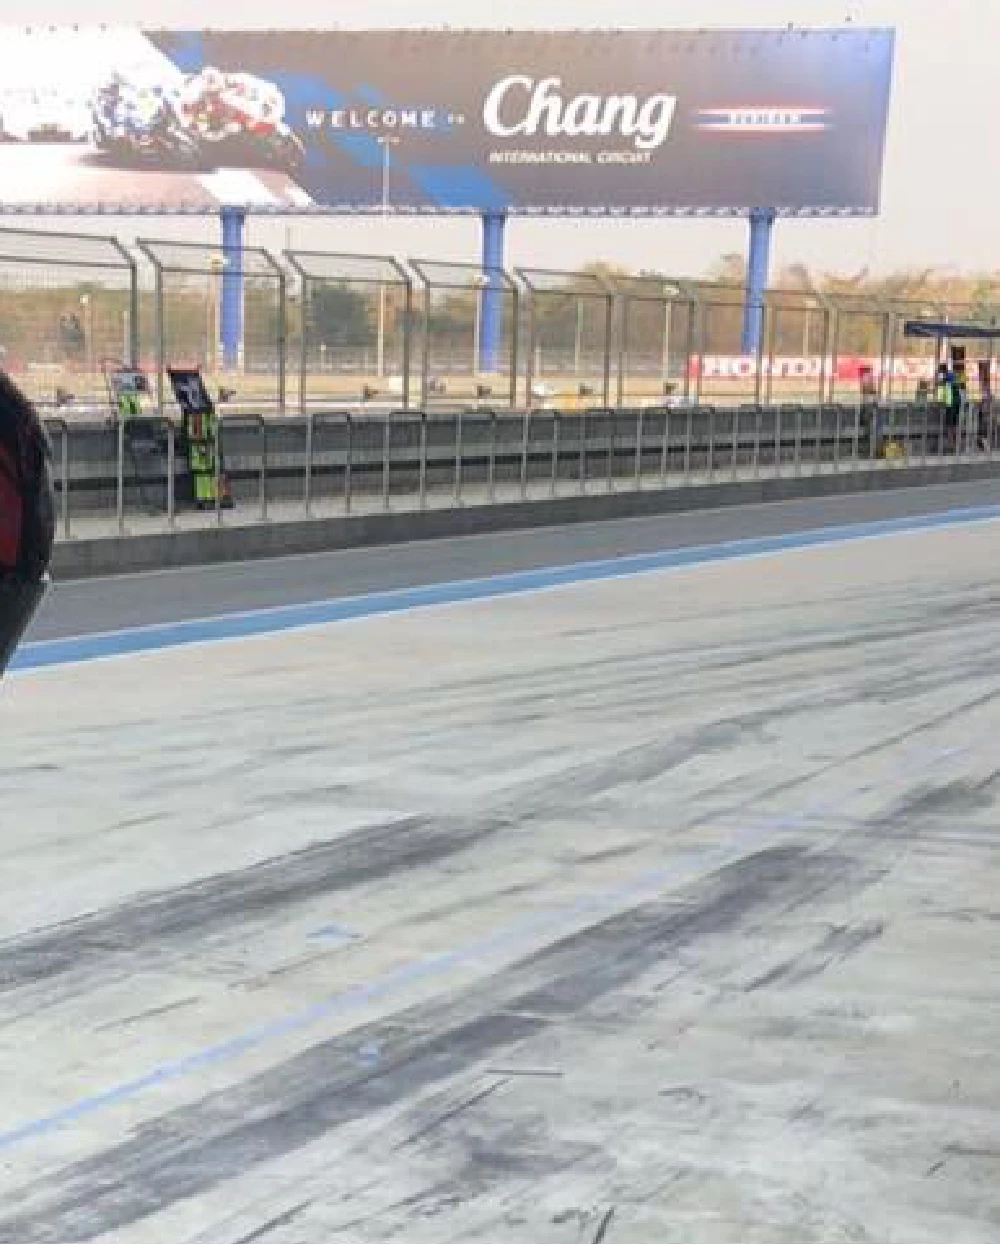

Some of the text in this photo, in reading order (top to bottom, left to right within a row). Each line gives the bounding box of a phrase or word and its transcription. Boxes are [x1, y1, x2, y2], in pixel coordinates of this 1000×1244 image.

[305, 109, 438, 129] WELCOME
[482, 74, 678, 148] Chang
[489, 151, 653, 164] INTERNATIONAL CIRCUIT
